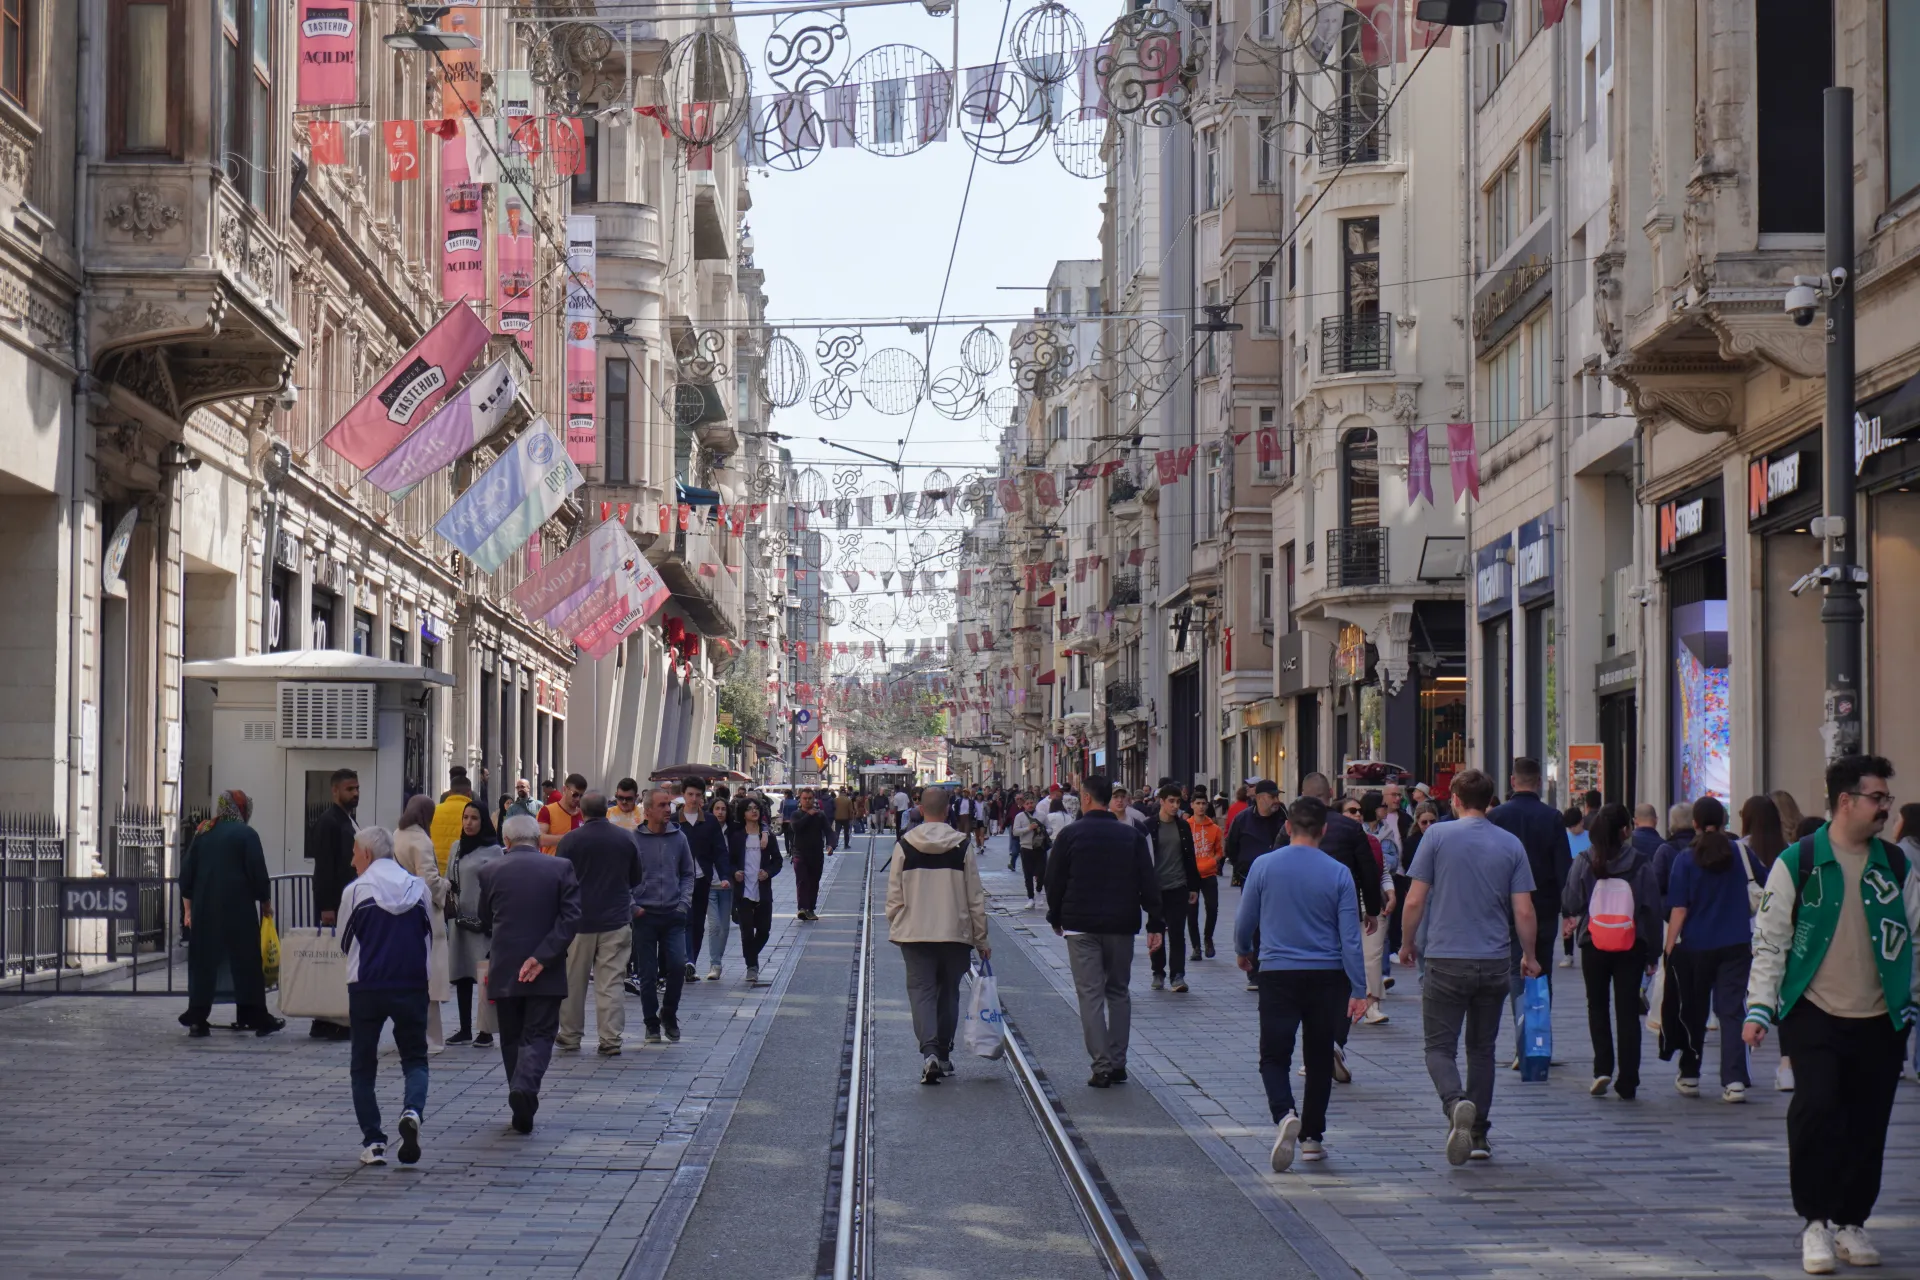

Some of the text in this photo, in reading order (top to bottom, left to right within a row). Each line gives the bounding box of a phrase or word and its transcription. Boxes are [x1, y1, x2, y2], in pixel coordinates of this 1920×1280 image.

[308, 22, 348, 33] TASTEHUB
[303, 51, 354, 66] AÇILDI!
[447, 61, 477, 73] NOW
[444, 71, 479, 83] OPEN!
[449, 239, 478, 250] TASTEHUB
[446, 261, 482, 273] AÇILDI!
[383, 361, 427, 404] GRANDPERA
[394, 372, 440, 419] TASTEHUB
[1750, 451, 1800, 521] N STREET
[1661, 498, 1703, 556] N STREET
[522, 558, 587, 611] MENDEL'S
[616, 607, 642, 631] TASTEHUB
[293, 950, 329, 960] ENGLISH
